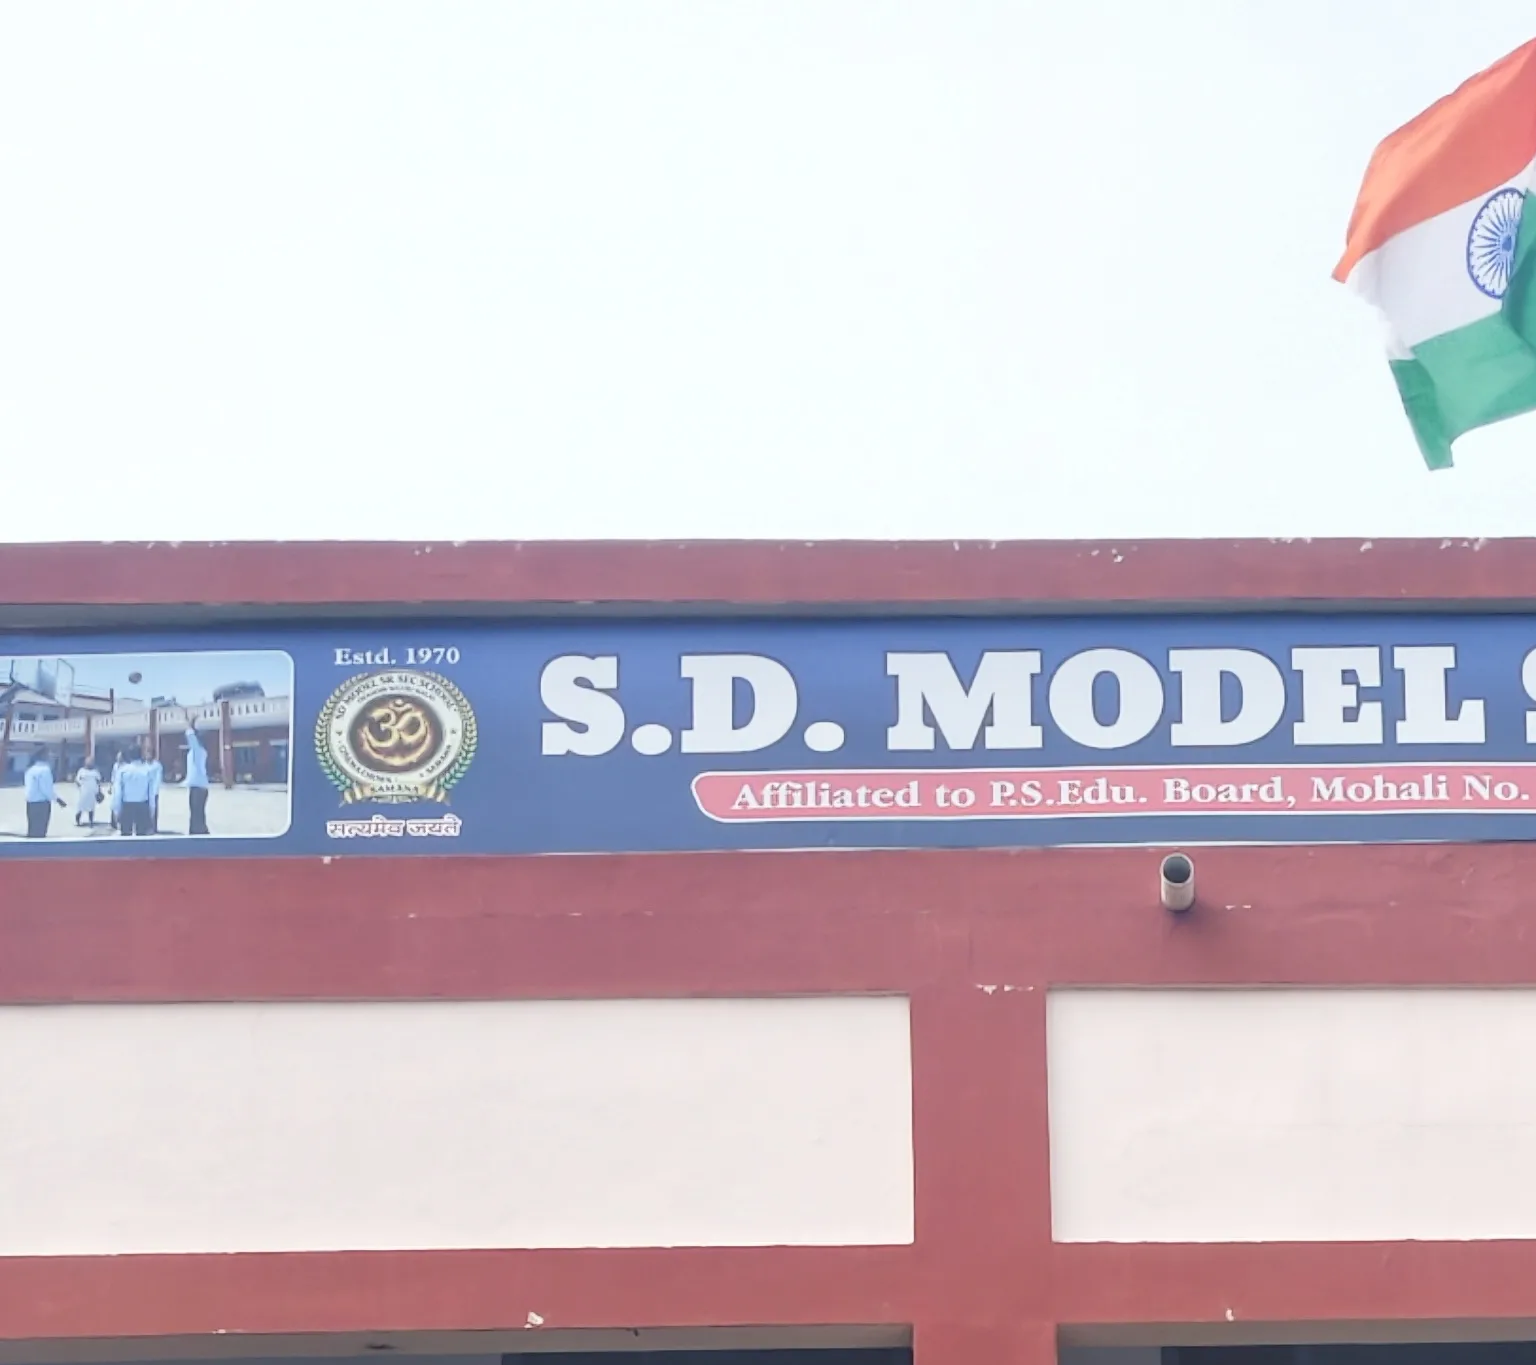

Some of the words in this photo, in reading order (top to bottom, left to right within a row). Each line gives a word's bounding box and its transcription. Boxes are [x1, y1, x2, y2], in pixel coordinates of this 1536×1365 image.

[334, 648, 397, 666] Estd.
[405, 646, 461, 665] 1970
[540, 653, 845, 757] S.D.
[885, 644, 1487, 751] MODEL
[731, 780, 920, 812] Affiliated
[935, 783, 976, 809] to
[1163, 776, 1296, 809] Board,
[1311, 773, 1450, 804] Mohali
[1462, 773, 1530, 802] No.
[327, 814, 405, 838] सत्यमेव
[406, 813, 462, 838] जयते
